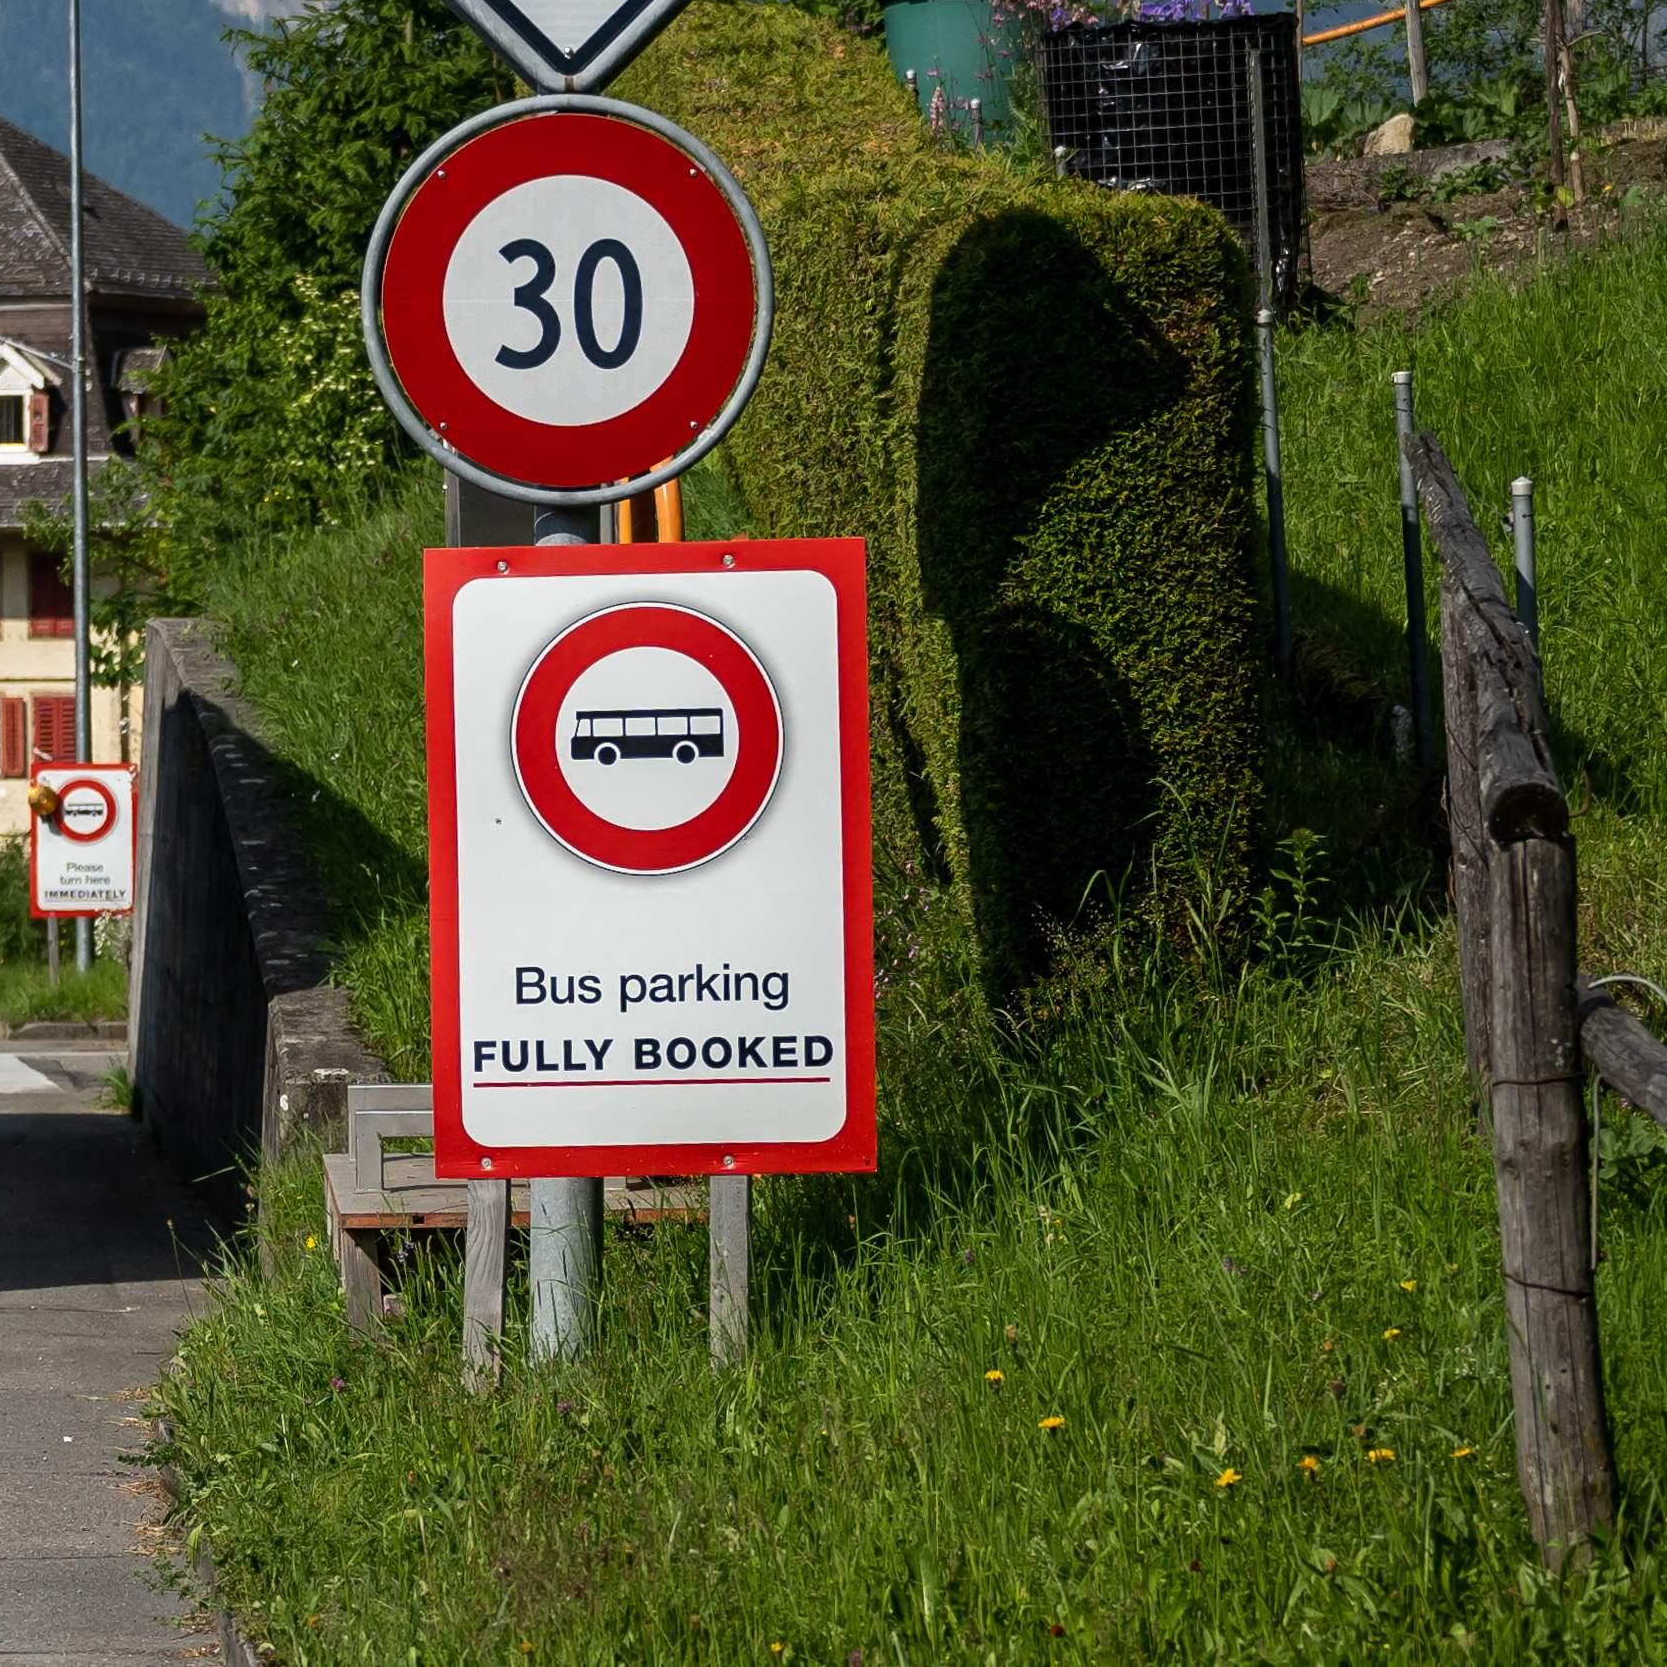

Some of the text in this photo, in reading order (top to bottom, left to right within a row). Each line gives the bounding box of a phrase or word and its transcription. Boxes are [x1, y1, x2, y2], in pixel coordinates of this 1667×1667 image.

[495, 238, 643, 370] 30
[59, 875, 111, 885] turn here
[66, 862, 104, 873] Please
[44, 889, 127, 900] IMMEDIATELY
[515, 963, 790, 1013] Bus parking
[473, 1034, 834, 1073] FULLY BOOKED
